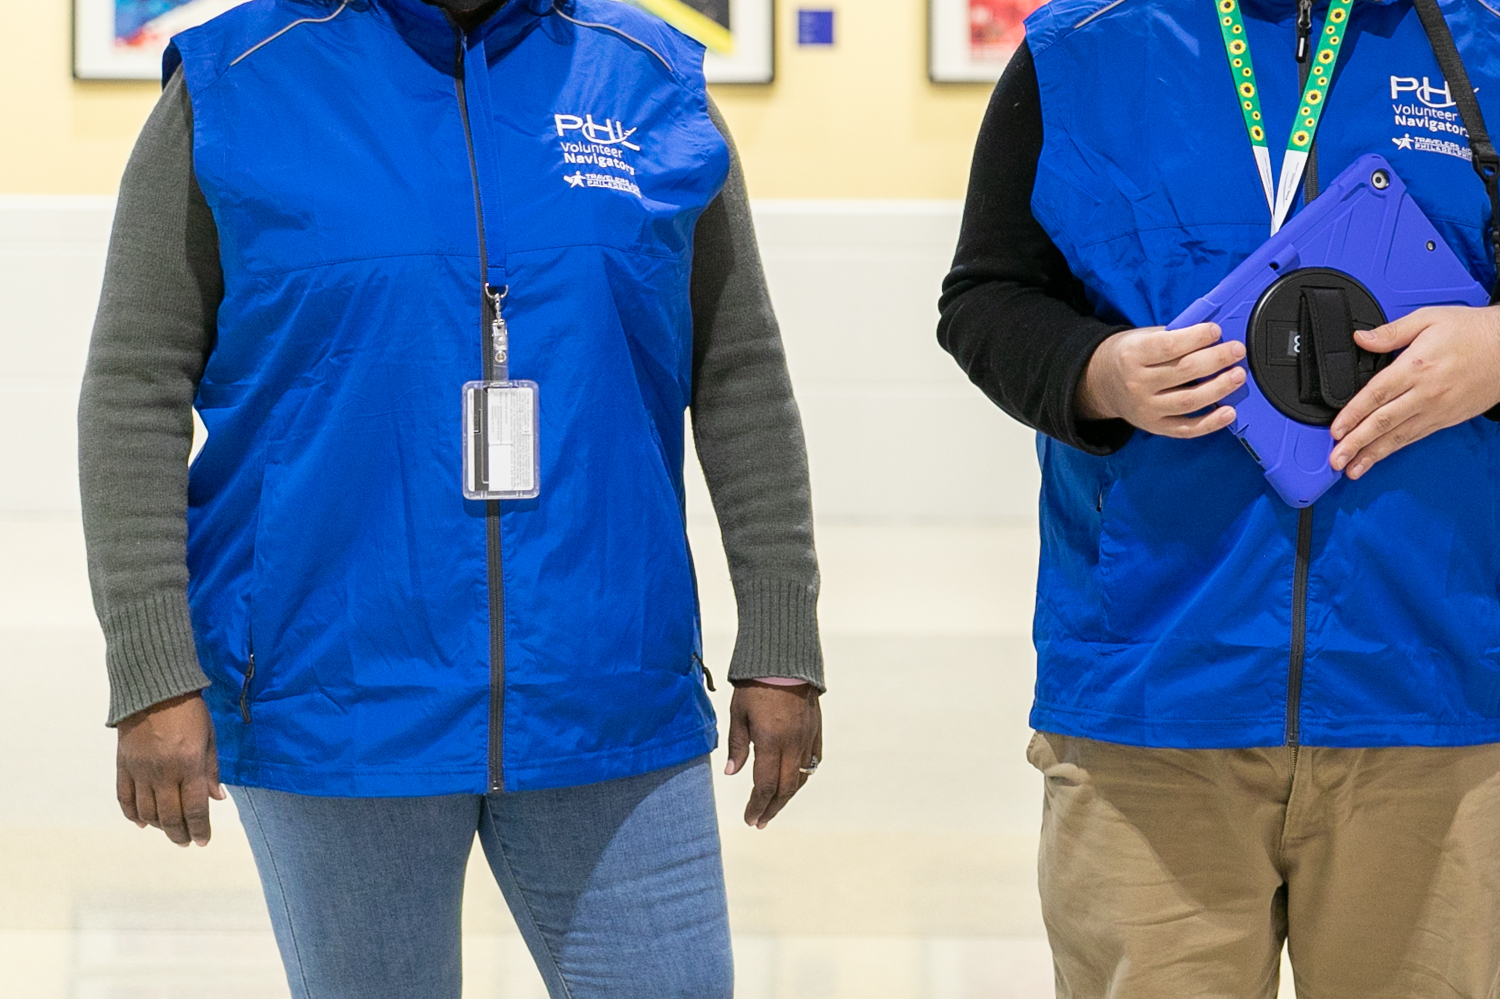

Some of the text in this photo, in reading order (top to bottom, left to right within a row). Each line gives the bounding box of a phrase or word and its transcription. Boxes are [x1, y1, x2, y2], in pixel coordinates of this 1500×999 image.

[1390, 75, 1456, 108] PH
[1392, 104, 1458, 121] Volunteer
[554, 113, 640, 151] PHL
[560, 141, 623, 158] Volunteer
[1414, 137, 1460, 149] TRAVELERS
[1414, 143, 1473, 161] PHILADELPHI
[564, 153, 635, 175] Navigators
